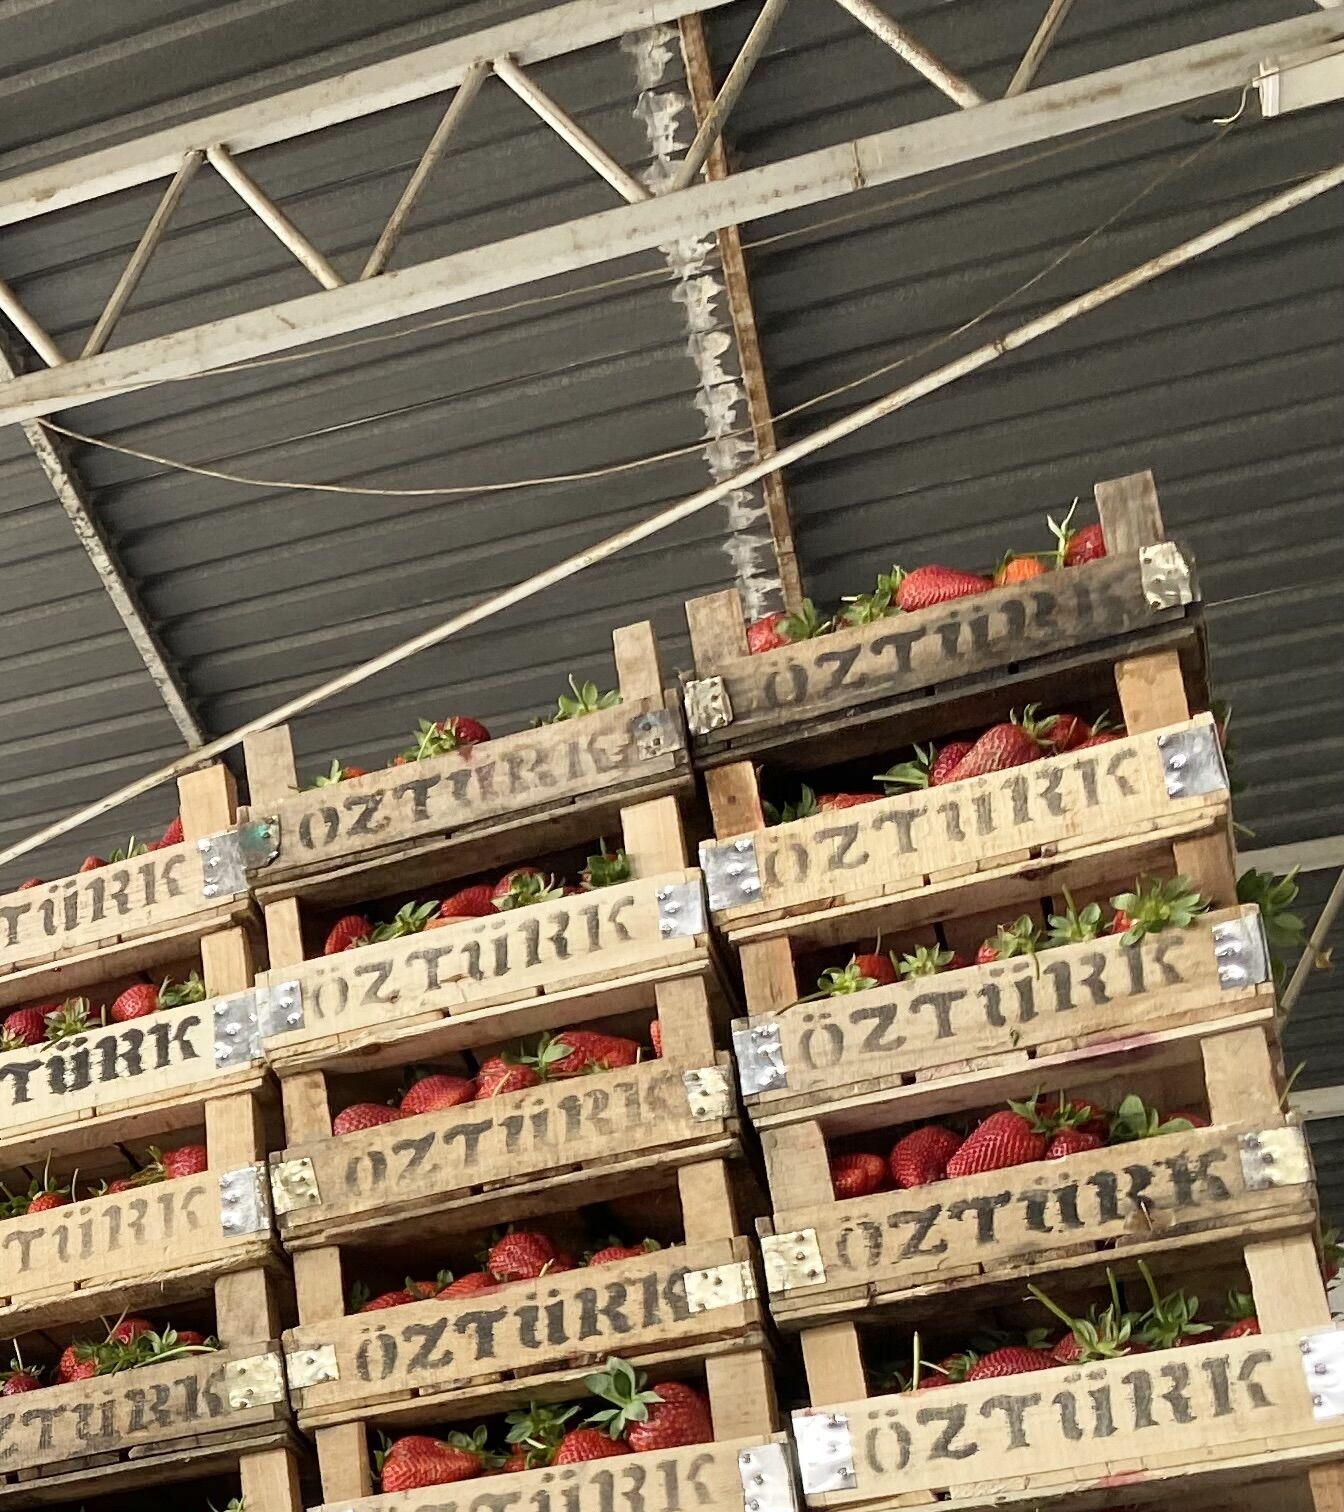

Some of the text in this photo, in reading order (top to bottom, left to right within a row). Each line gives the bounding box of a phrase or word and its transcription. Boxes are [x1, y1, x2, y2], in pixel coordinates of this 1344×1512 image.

[763, 748, 1137, 889] ÖZTÜRK
[314, 896, 634, 1019] ÖZTÜRK
[799, 935, 1186, 1070] ÖZTÜRK
[836, 1147, 1230, 1271] ÖZTÜRK
[356, 1267, 700, 1382] ÖZTÜRK
[865, 1349, 1275, 1475] ÖZTÜRK
